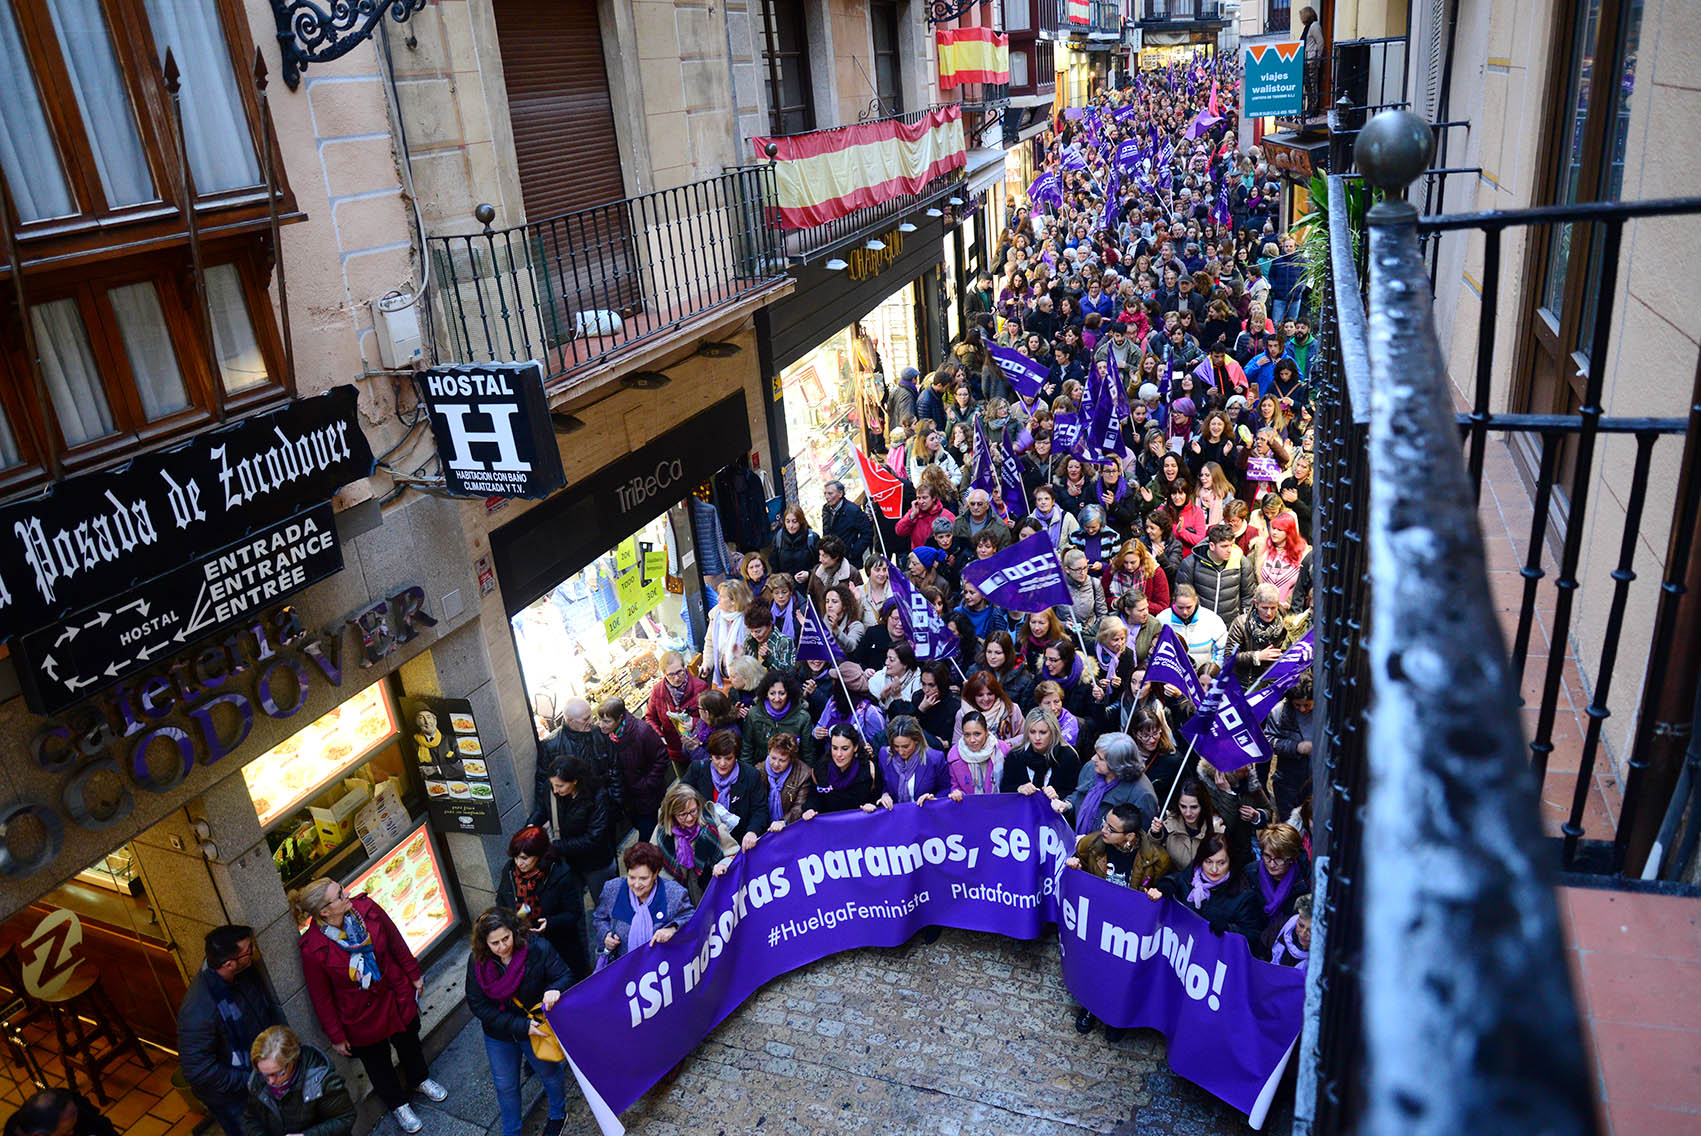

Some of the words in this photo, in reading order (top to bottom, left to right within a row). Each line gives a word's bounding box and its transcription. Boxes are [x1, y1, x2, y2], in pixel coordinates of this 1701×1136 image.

[1251, 84, 1297, 94] walistour
[1260, 72, 1289, 82] viajes
[427, 374, 515, 397] HOSTAL
[433, 402, 533, 472] H
[455, 470, 493, 482] HABITACION
[493, 472, 508, 482] CON
[509, 470, 528, 483] BAÑO
[463, 481, 506, 493] CLIMATIZADA
[505, 483, 512, 493] Y
[615, 458, 683, 513] TriBeCa
[13, 488, 158, 606] Posada
[159, 467, 207, 531] de
[209, 418, 351, 512] Zocodover
[203, 517, 319, 582] ENTRADA
[209, 530, 334, 603] ENTRANCE
[214, 565, 307, 623] ENTRÉE
[119, 609, 180, 647] HOSTAL
[683, 866, 791, 994] nosotras
[798, 833, 980, 897] paramos,
[990, 826, 1031, 862] se
[1062, 895, 1090, 942] el
[1100, 920, 1228, 1012] mundo!
[767, 888, 930, 948] #HuelgaFeminista
